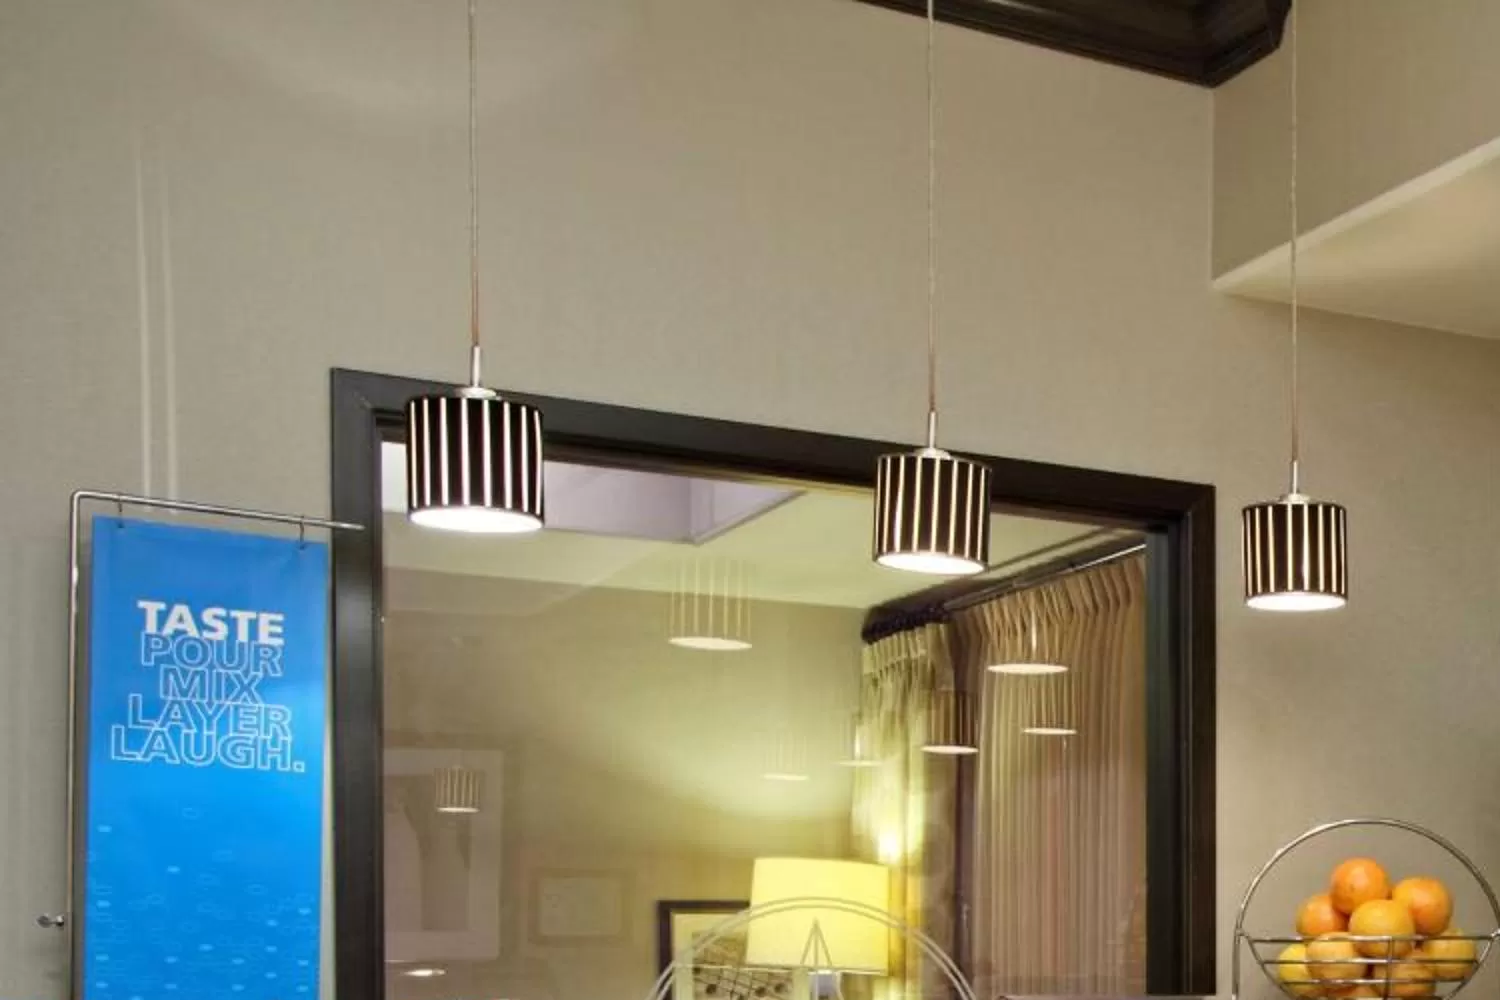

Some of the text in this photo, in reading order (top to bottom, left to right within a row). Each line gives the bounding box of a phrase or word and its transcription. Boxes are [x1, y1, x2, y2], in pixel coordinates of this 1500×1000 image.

[137, 600, 284, 645] TASTE
[140, 632, 283, 676] POUR
[159, 664, 265, 705] MIX
[127, 693, 293, 740] LAYER
[110, 724, 305, 773] LAUGH.
